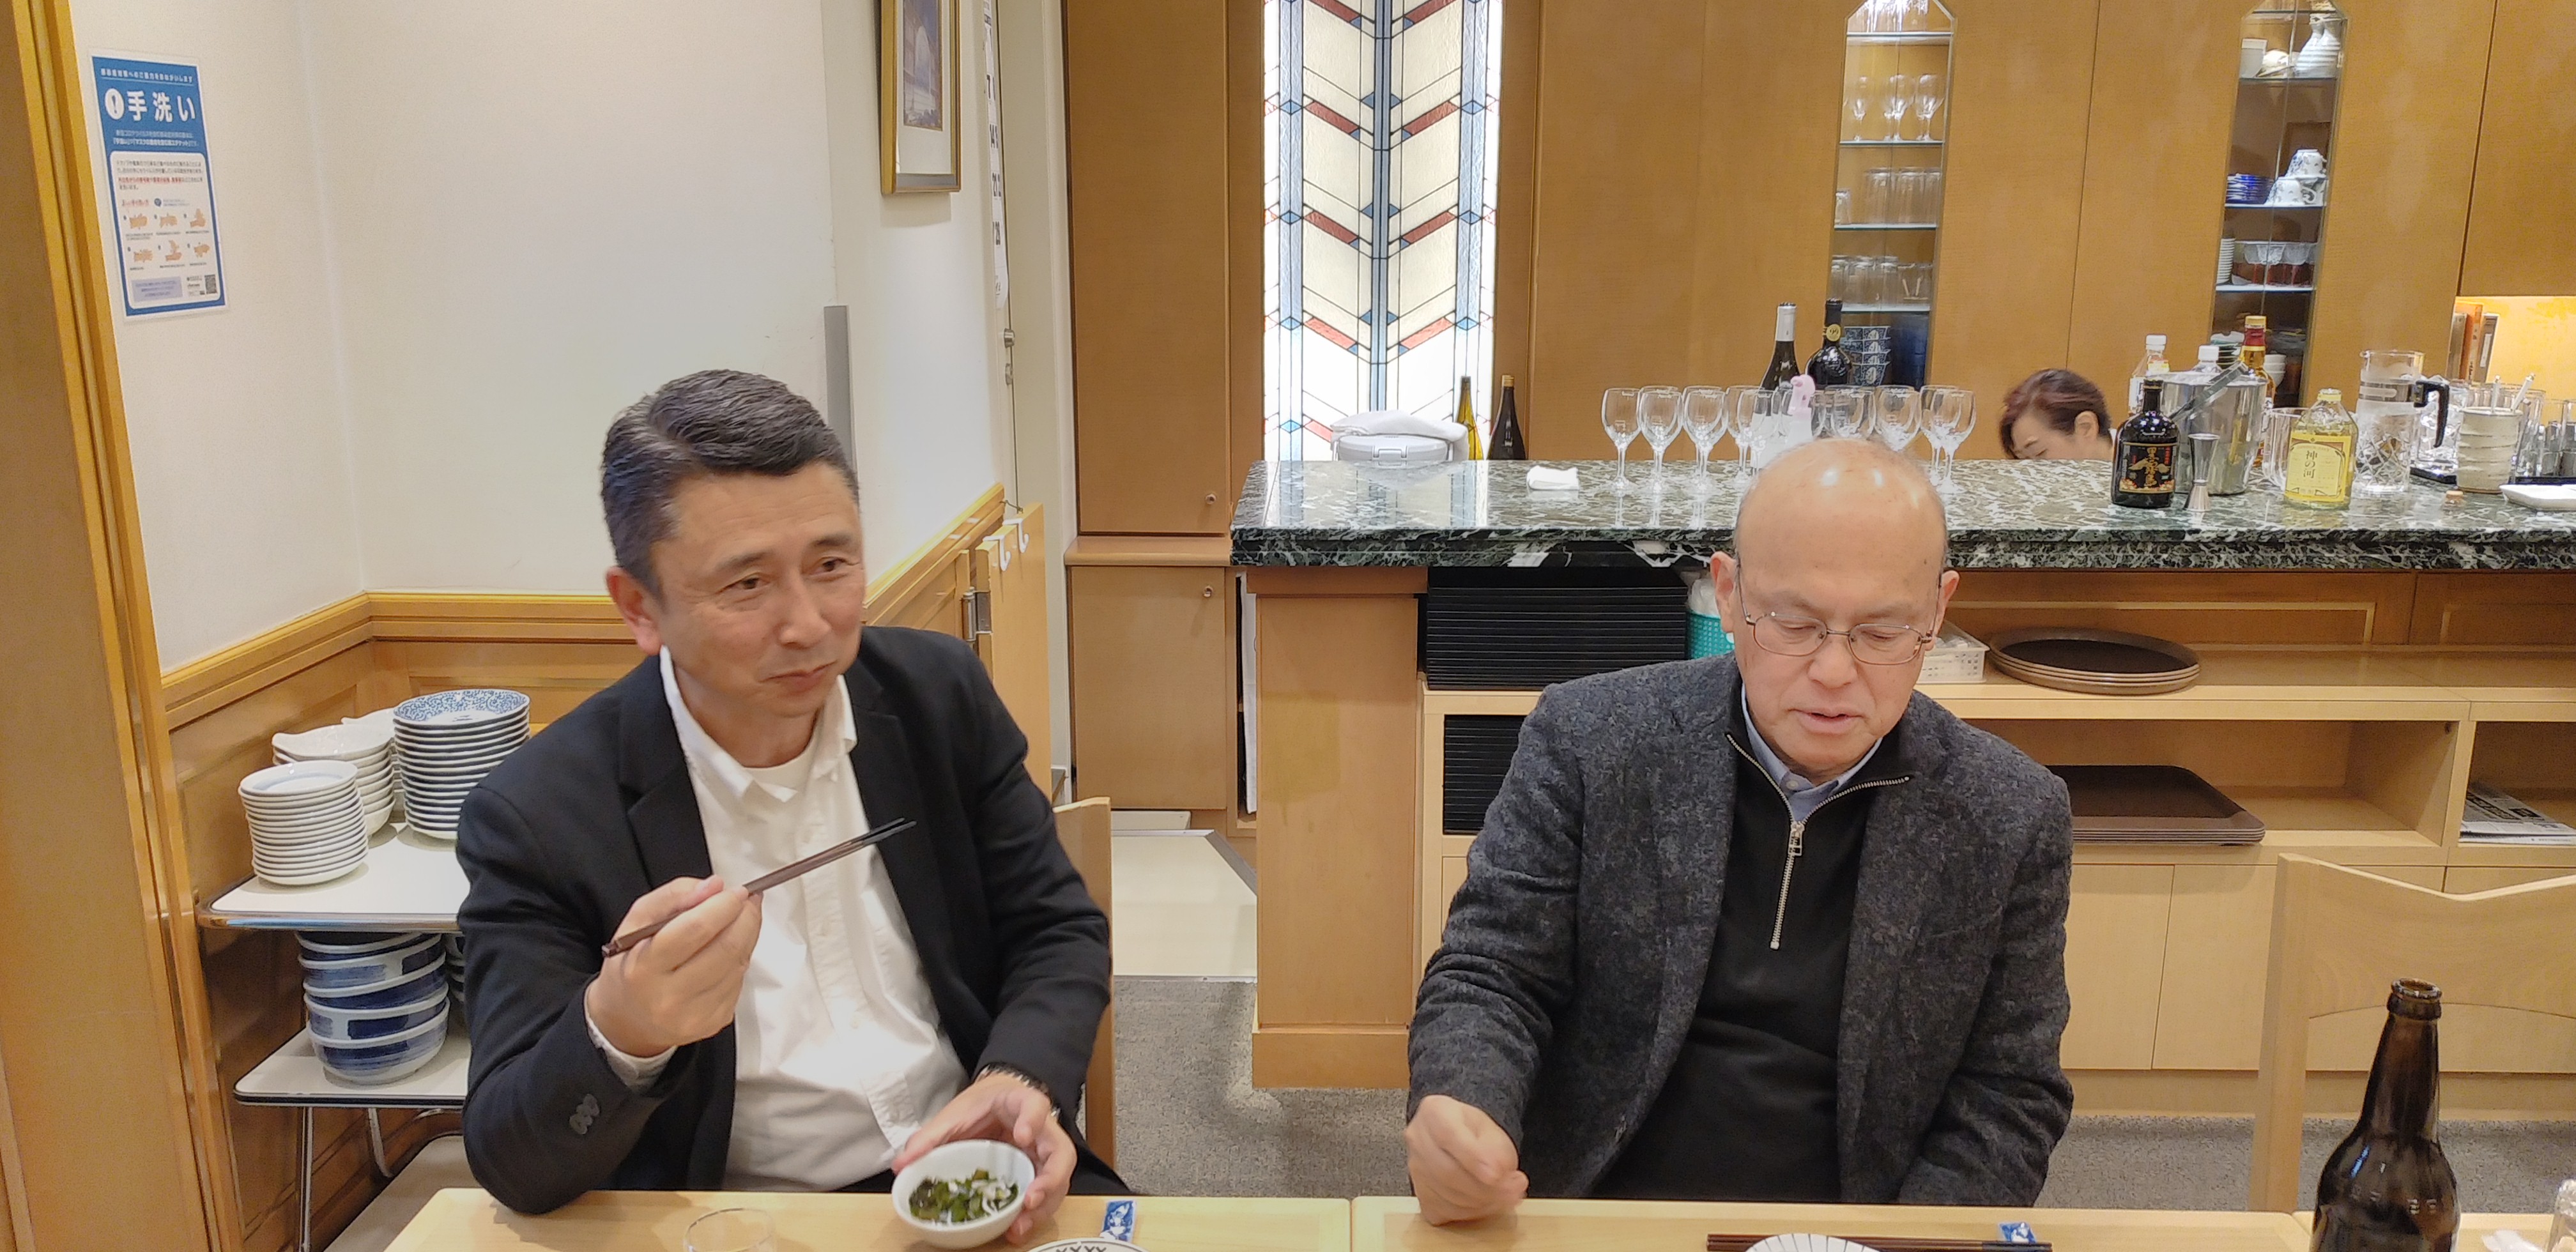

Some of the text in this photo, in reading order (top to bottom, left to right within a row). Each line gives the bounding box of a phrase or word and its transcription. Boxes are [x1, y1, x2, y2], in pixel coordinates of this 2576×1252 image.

[126, 90, 195, 123] 手洗い
[2303, 450, 2318, 479] 神の河
